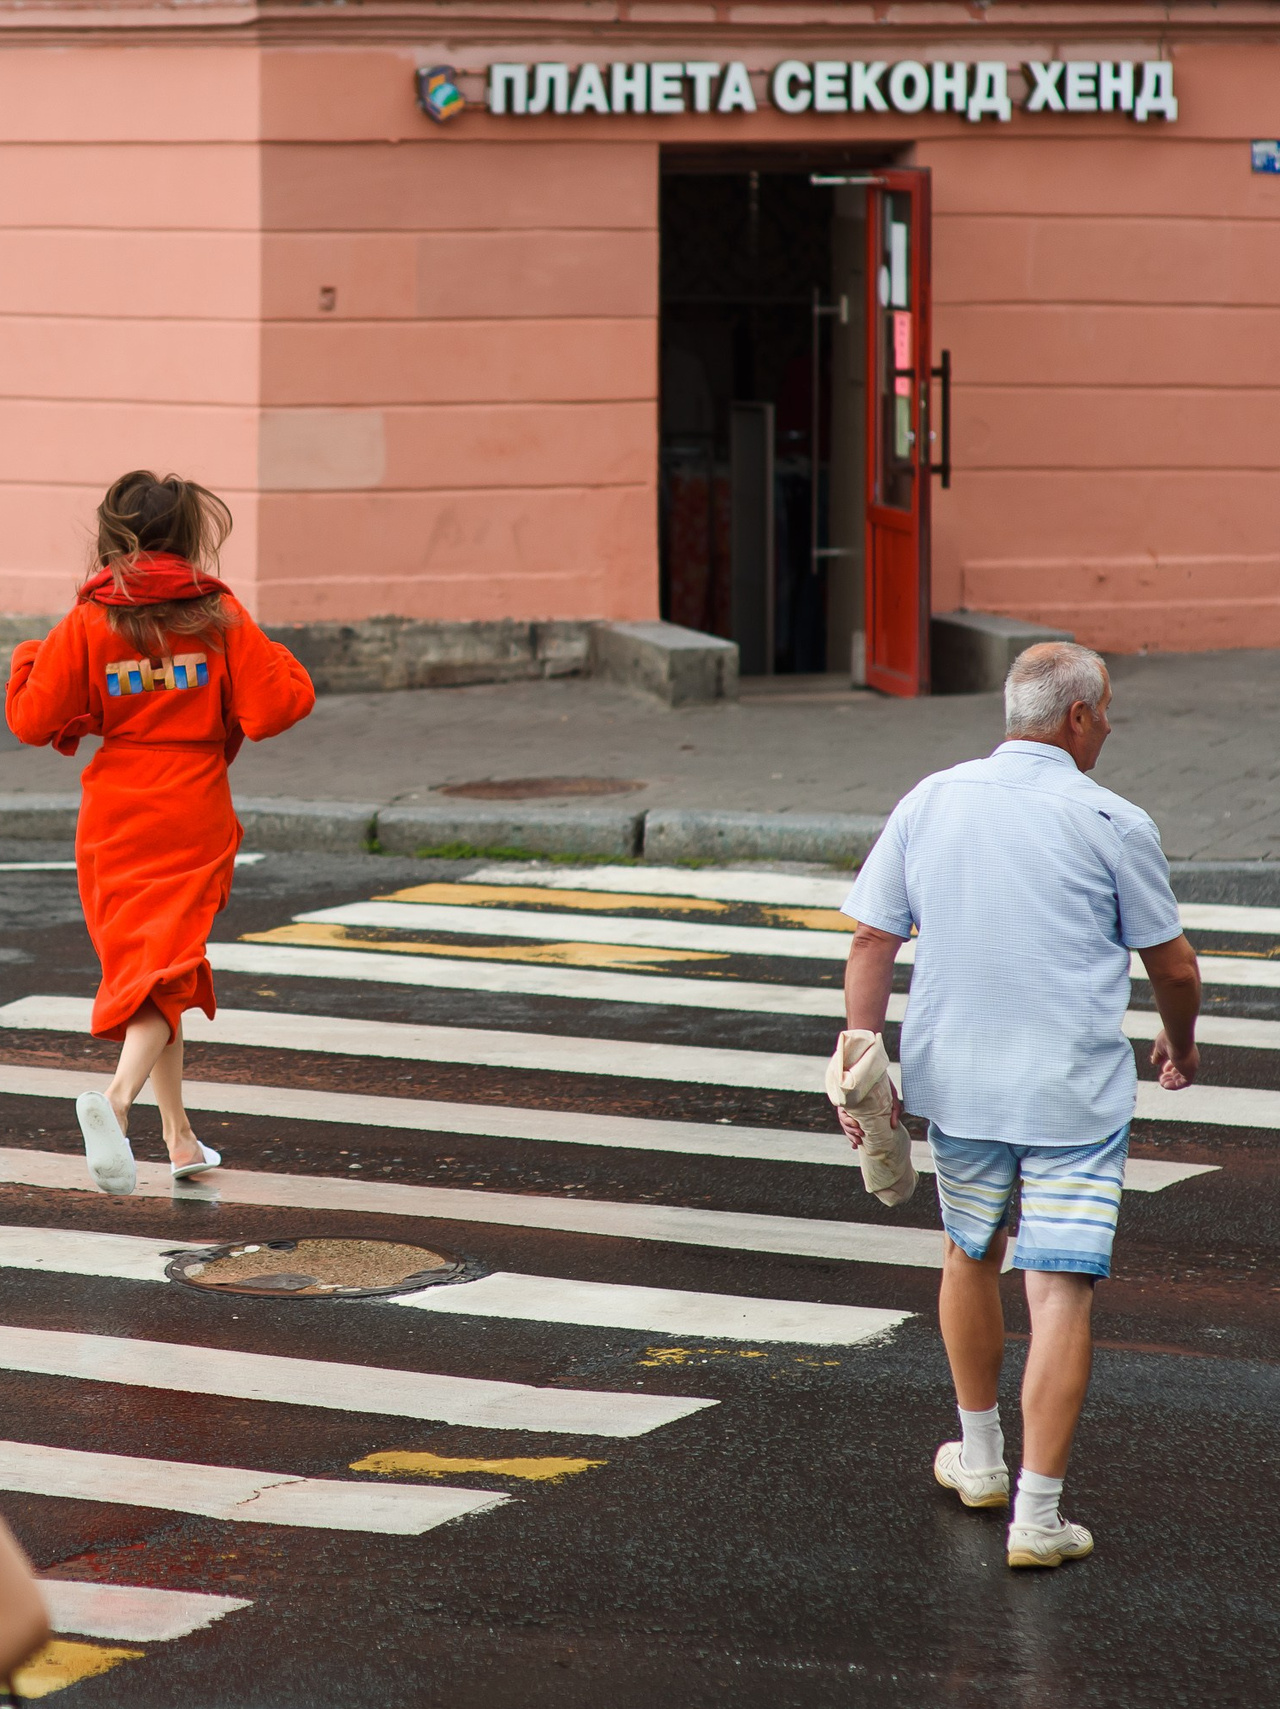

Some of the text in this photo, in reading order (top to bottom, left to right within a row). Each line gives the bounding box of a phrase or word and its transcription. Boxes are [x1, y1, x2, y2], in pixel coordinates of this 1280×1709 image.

[488, 59, 1179, 123] ПЛАНЕТА СЕКОНД ХЕНД
[105, 653, 210, 698] ТНТ
